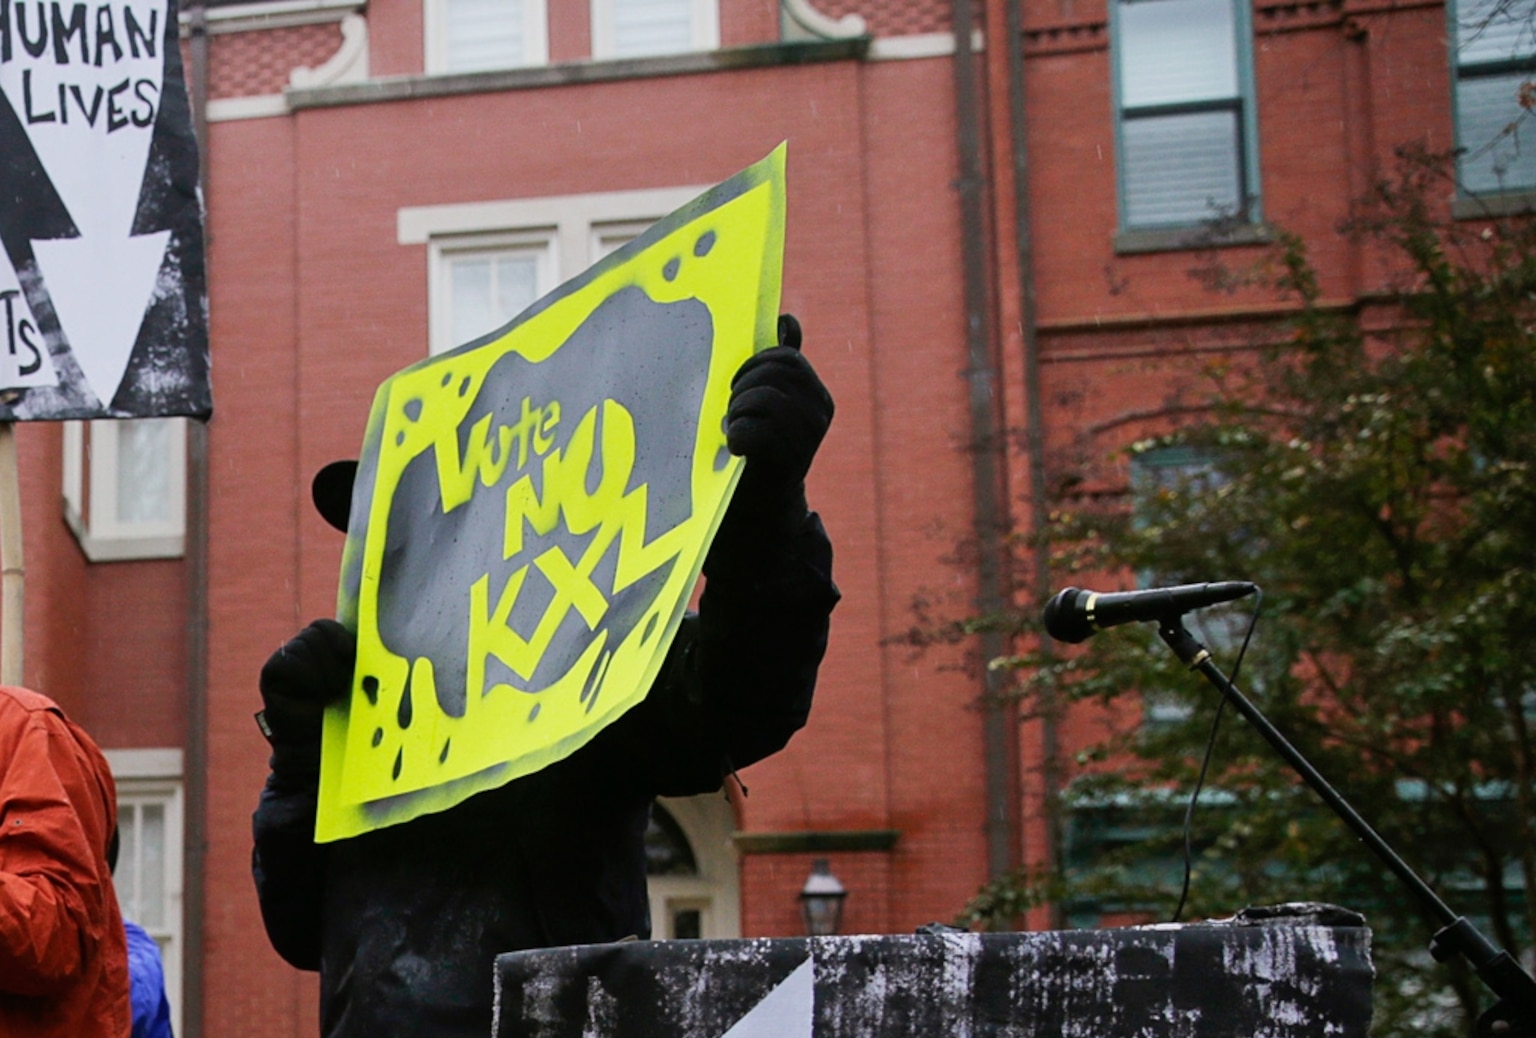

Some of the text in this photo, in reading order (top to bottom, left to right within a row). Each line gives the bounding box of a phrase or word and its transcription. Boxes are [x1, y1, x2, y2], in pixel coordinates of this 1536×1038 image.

[23, 69, 158, 134] LIVES
[435, 396, 561, 513] Vote
[504, 398, 635, 560] NO
[467, 483, 689, 695] KXL
